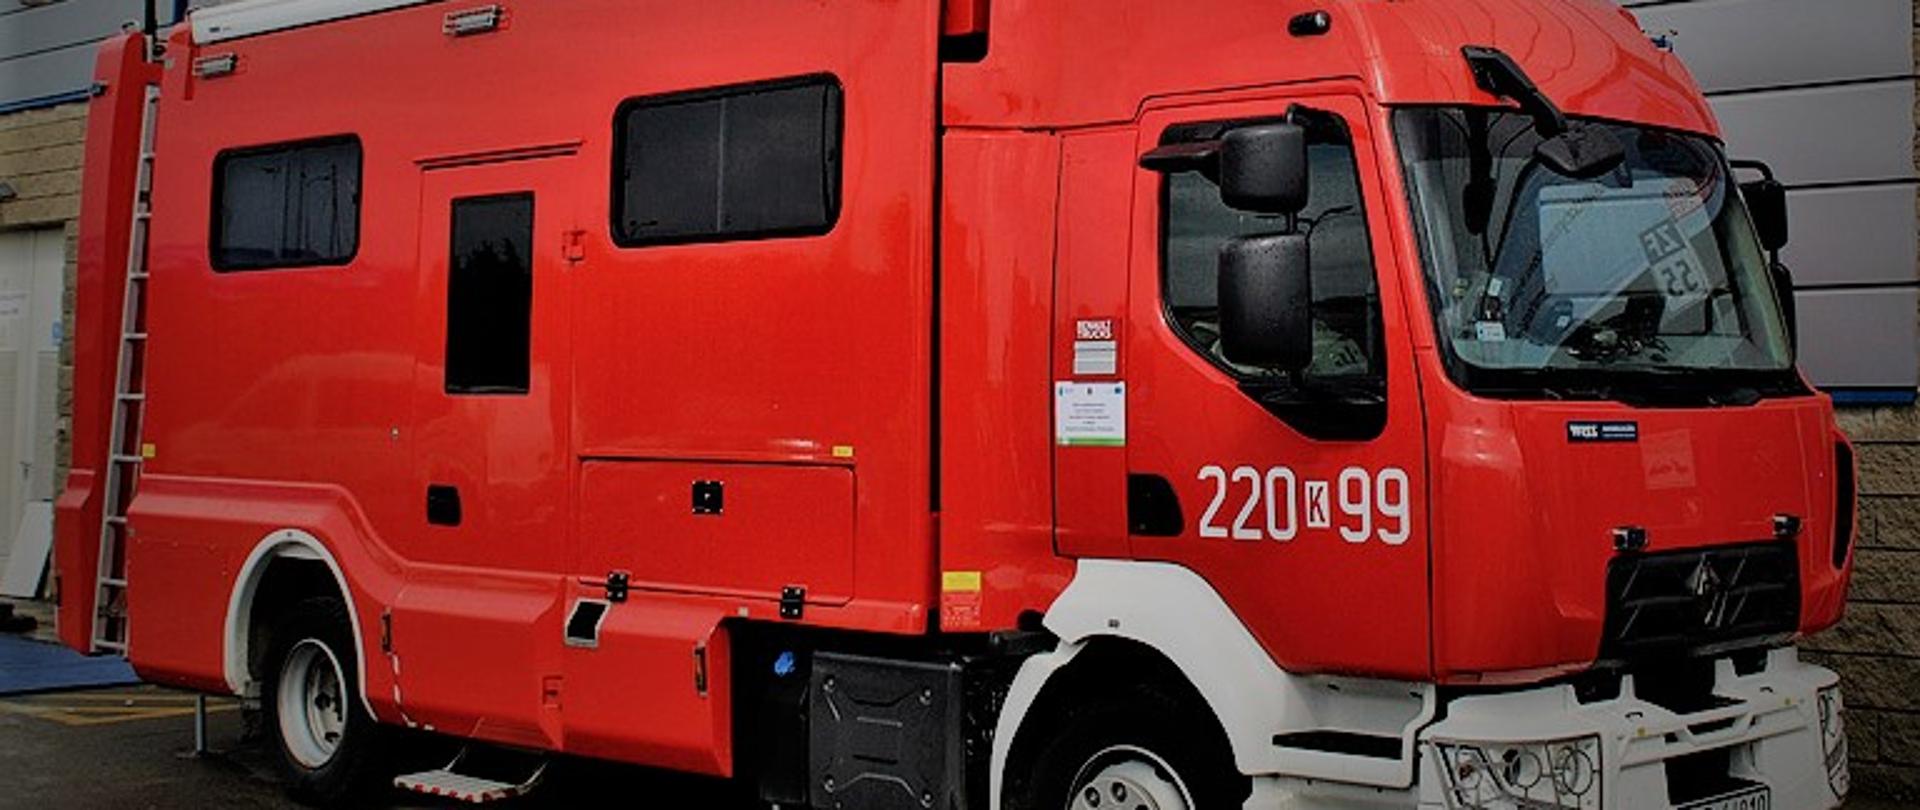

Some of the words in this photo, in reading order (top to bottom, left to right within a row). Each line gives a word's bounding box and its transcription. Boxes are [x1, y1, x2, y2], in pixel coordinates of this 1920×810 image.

[1197, 465, 1298, 541] 220
[1307, 484, 1328, 525] K
[1338, 467, 1411, 545] 99
